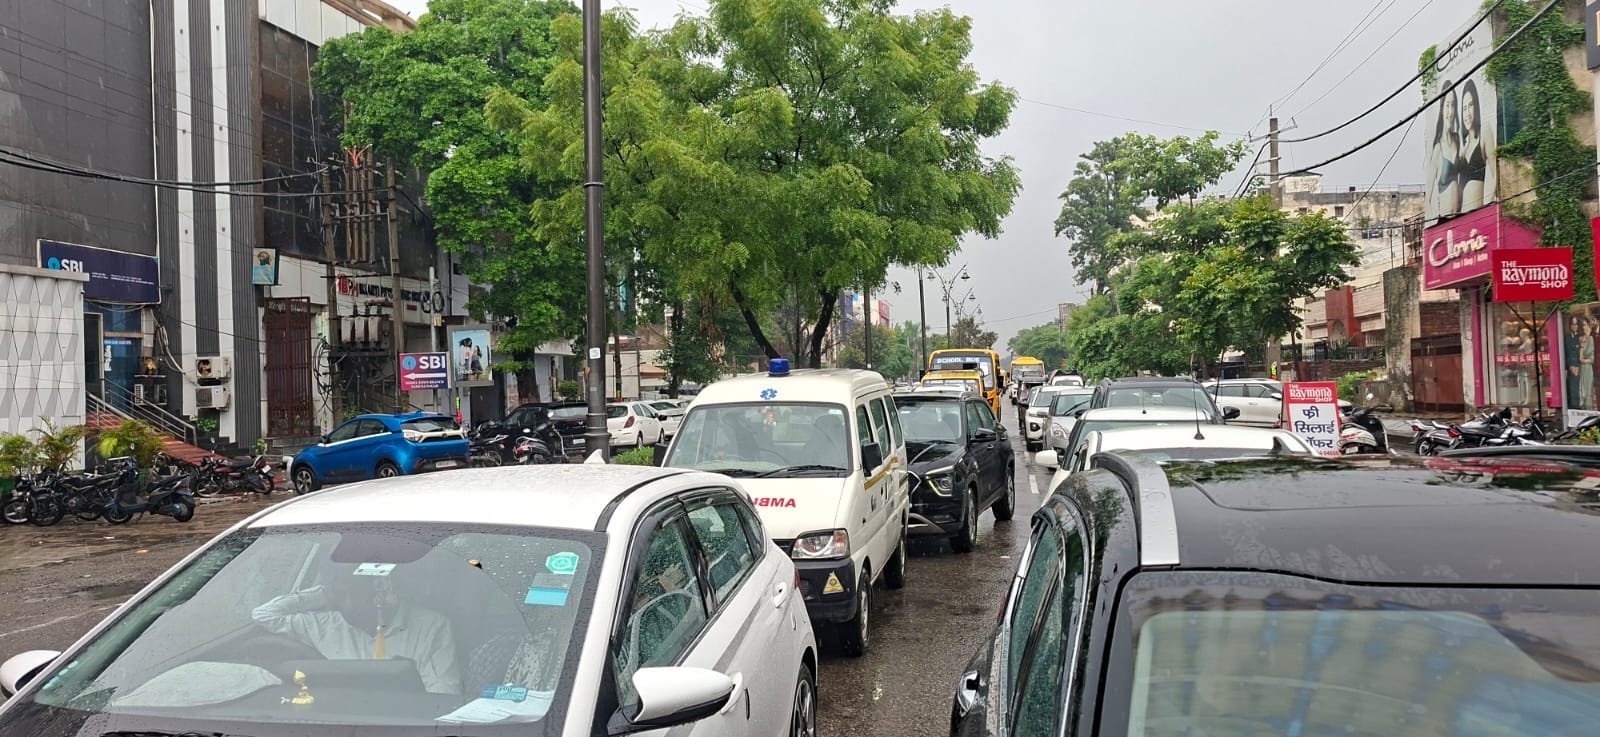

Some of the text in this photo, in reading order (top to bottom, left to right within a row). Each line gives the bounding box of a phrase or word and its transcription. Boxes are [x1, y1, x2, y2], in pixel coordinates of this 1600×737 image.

[1429, 229, 1488, 267] Clovia
[61, 259, 84, 273] SBI
[1501, 264, 1568, 286] Raymond
[419, 356, 446, 369] SBI
[1290, 387, 1332, 400] Raymond
[1294, 420, 1335, 434] सिलाई
